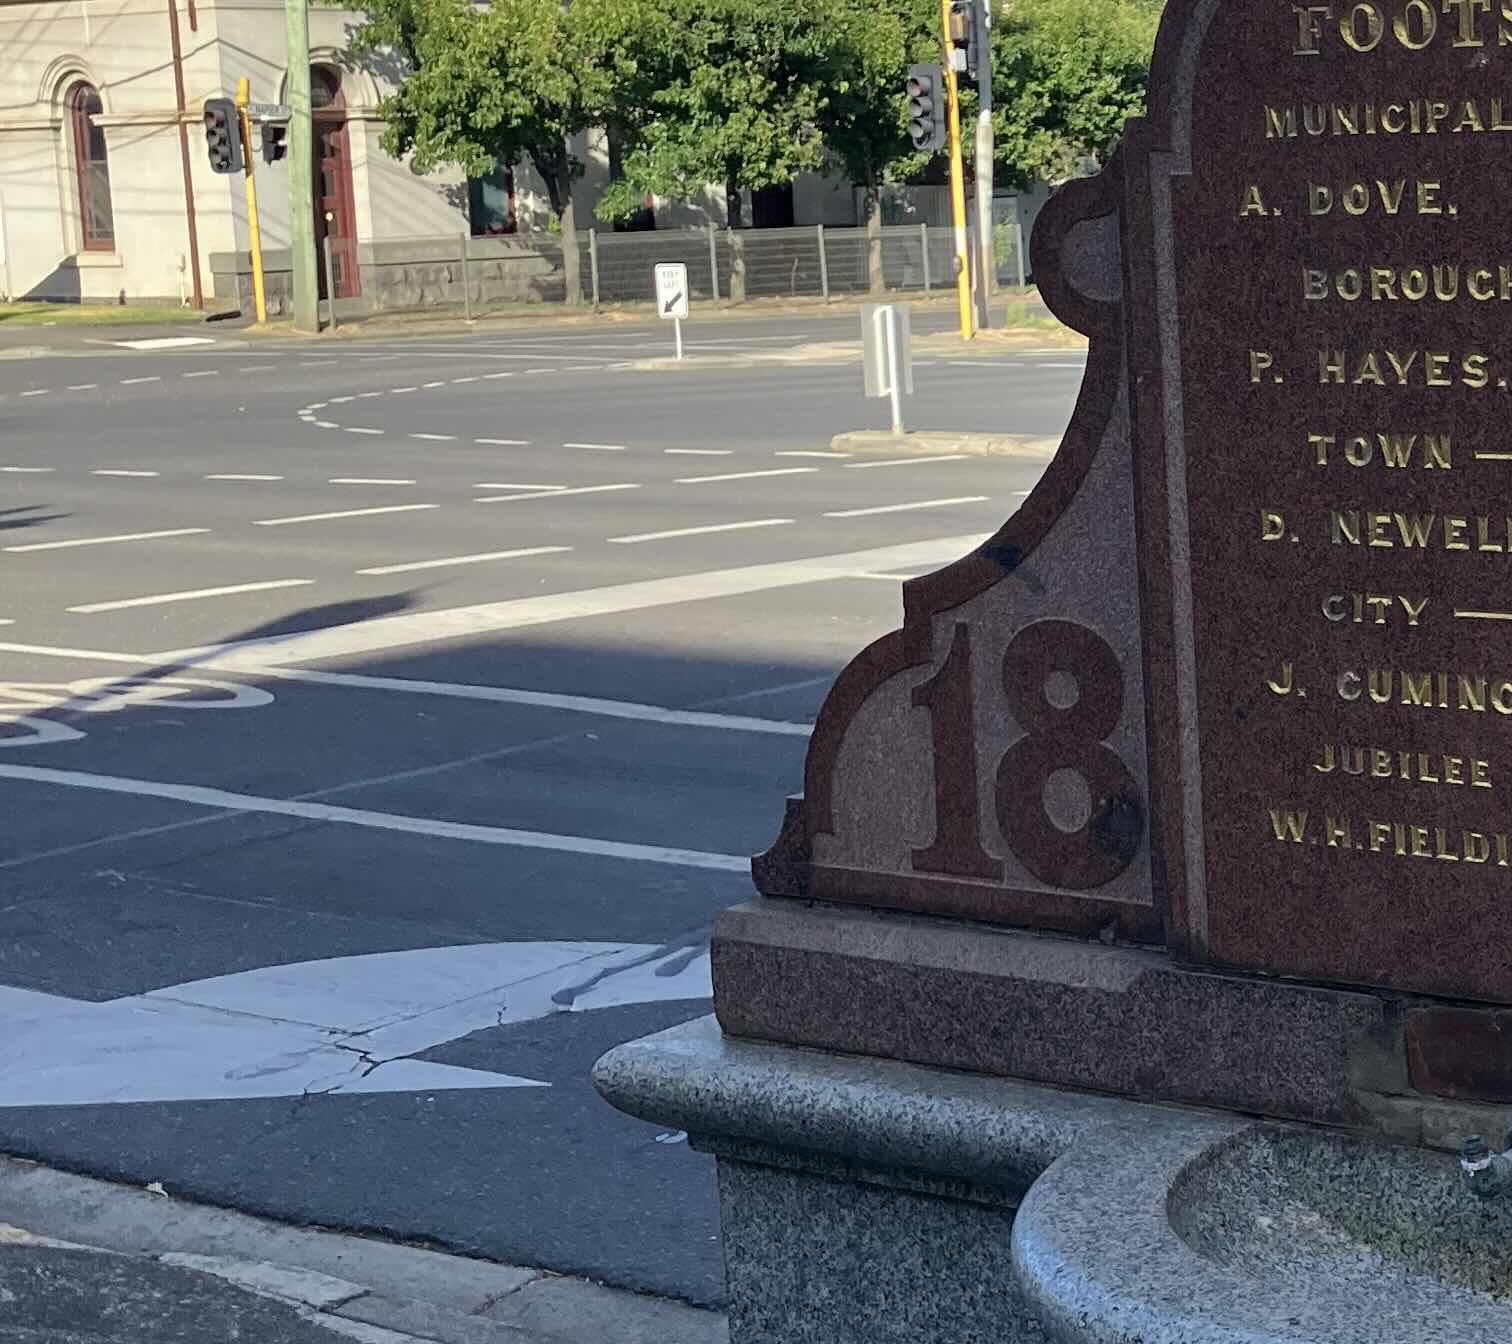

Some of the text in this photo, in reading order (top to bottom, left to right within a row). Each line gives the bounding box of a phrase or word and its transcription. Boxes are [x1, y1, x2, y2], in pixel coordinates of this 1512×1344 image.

[1238, 185, 1283, 217] A.
[1249, 351, 1284, 386] P.
[1307, 431, 1454, 470] TOWN
[1260, 509, 1301, 544] D.
[1321, 593, 1430, 626] CITY
[1267, 662, 1307, 698] J.
[910, 617, 1146, 891] 18
[1312, 743, 1493, 789] JUBILEE
